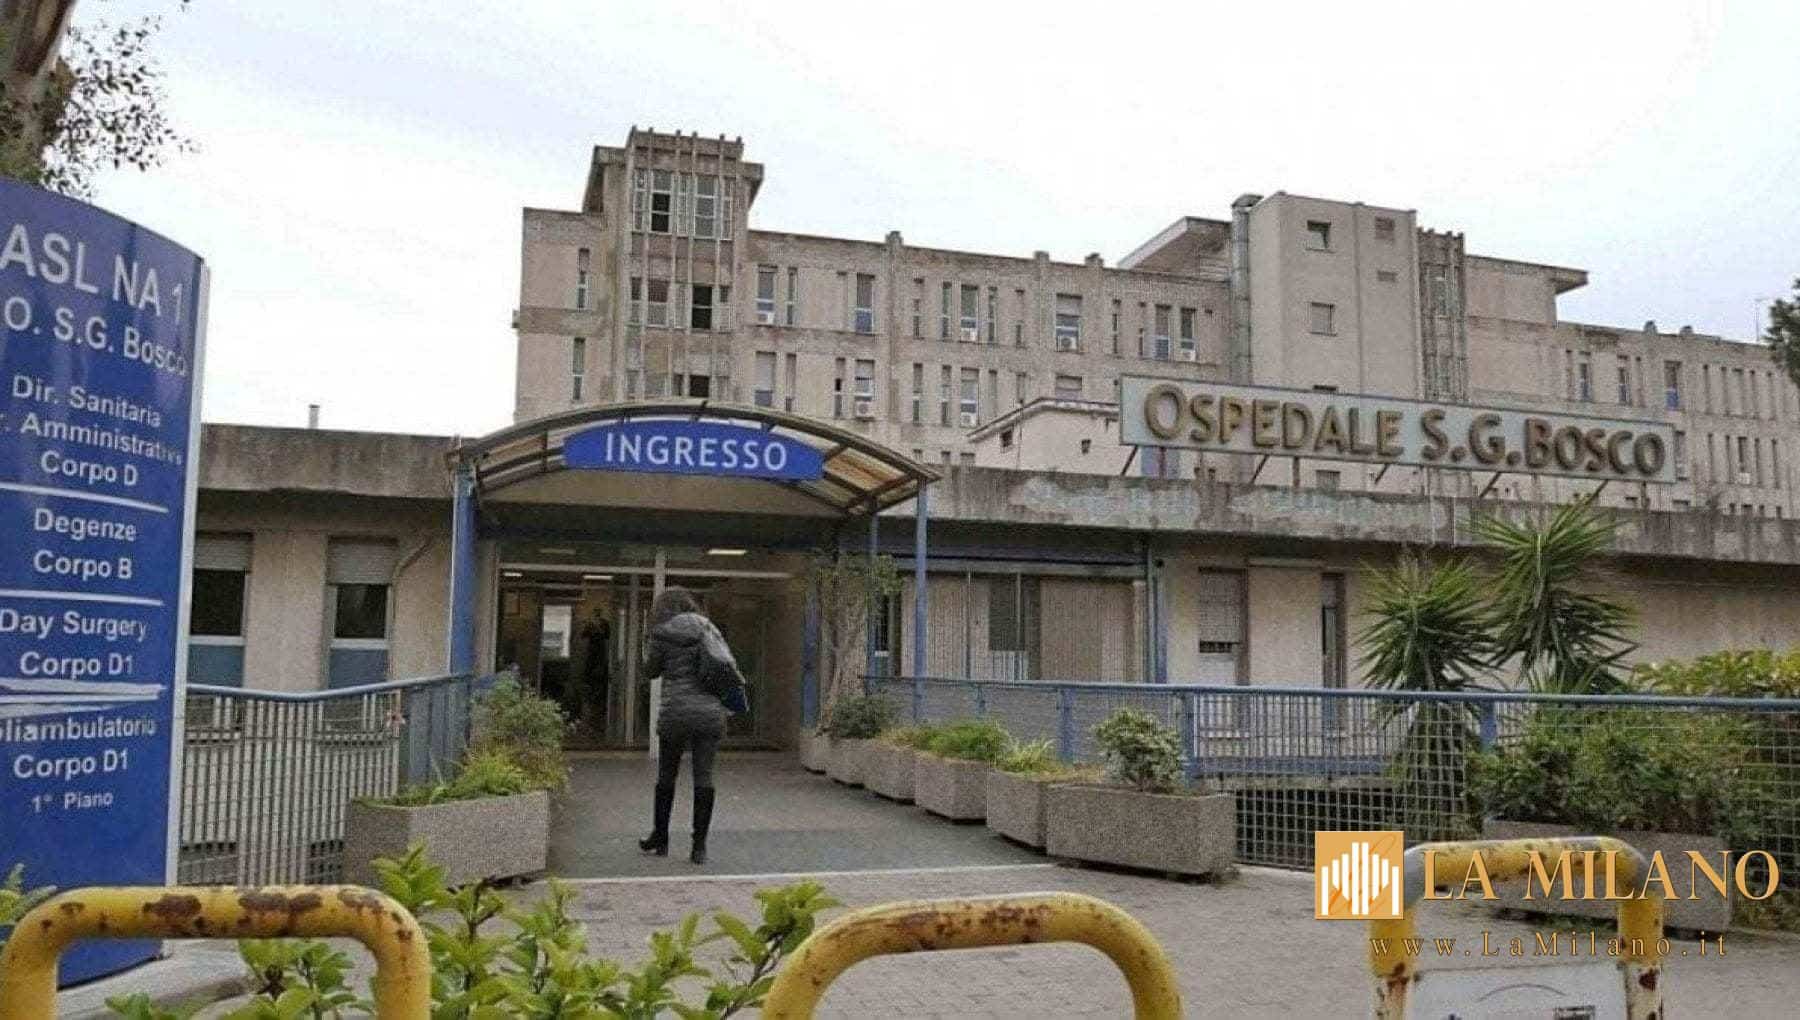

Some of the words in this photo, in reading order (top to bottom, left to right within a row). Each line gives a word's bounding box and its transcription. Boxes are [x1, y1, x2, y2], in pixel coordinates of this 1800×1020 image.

[0, 223, 99, 294] ASL
[112, 253, 161, 317] NA
[171, 283, 183, 326] 1
[4, 296, 41, 336] O.
[53, 306, 114, 353] S.G.
[12, 375, 59, 404] Dir.
[69, 384, 162, 428] Sanitaria
[1144, 383, 1405, 457] OSPEDALE
[41, 450, 117, 484] Corpo
[124, 463, 138, 486] D
[604, 432, 787, 471] INGRESSO
[34, 507, 137, 541] Degenze
[33, 550, 112, 580] Corpo
[117, 558, 133, 579] B
[0, 608, 54, 639] Day
[63, 610, 147, 642] Surgery
[20, 651, 101, 680] Corpo
[108, 653, 133, 676] D1
[13, 753, 96, 780] Corpo
[103, 748, 129, 772] D1
[64, 790, 113, 810] Piano
